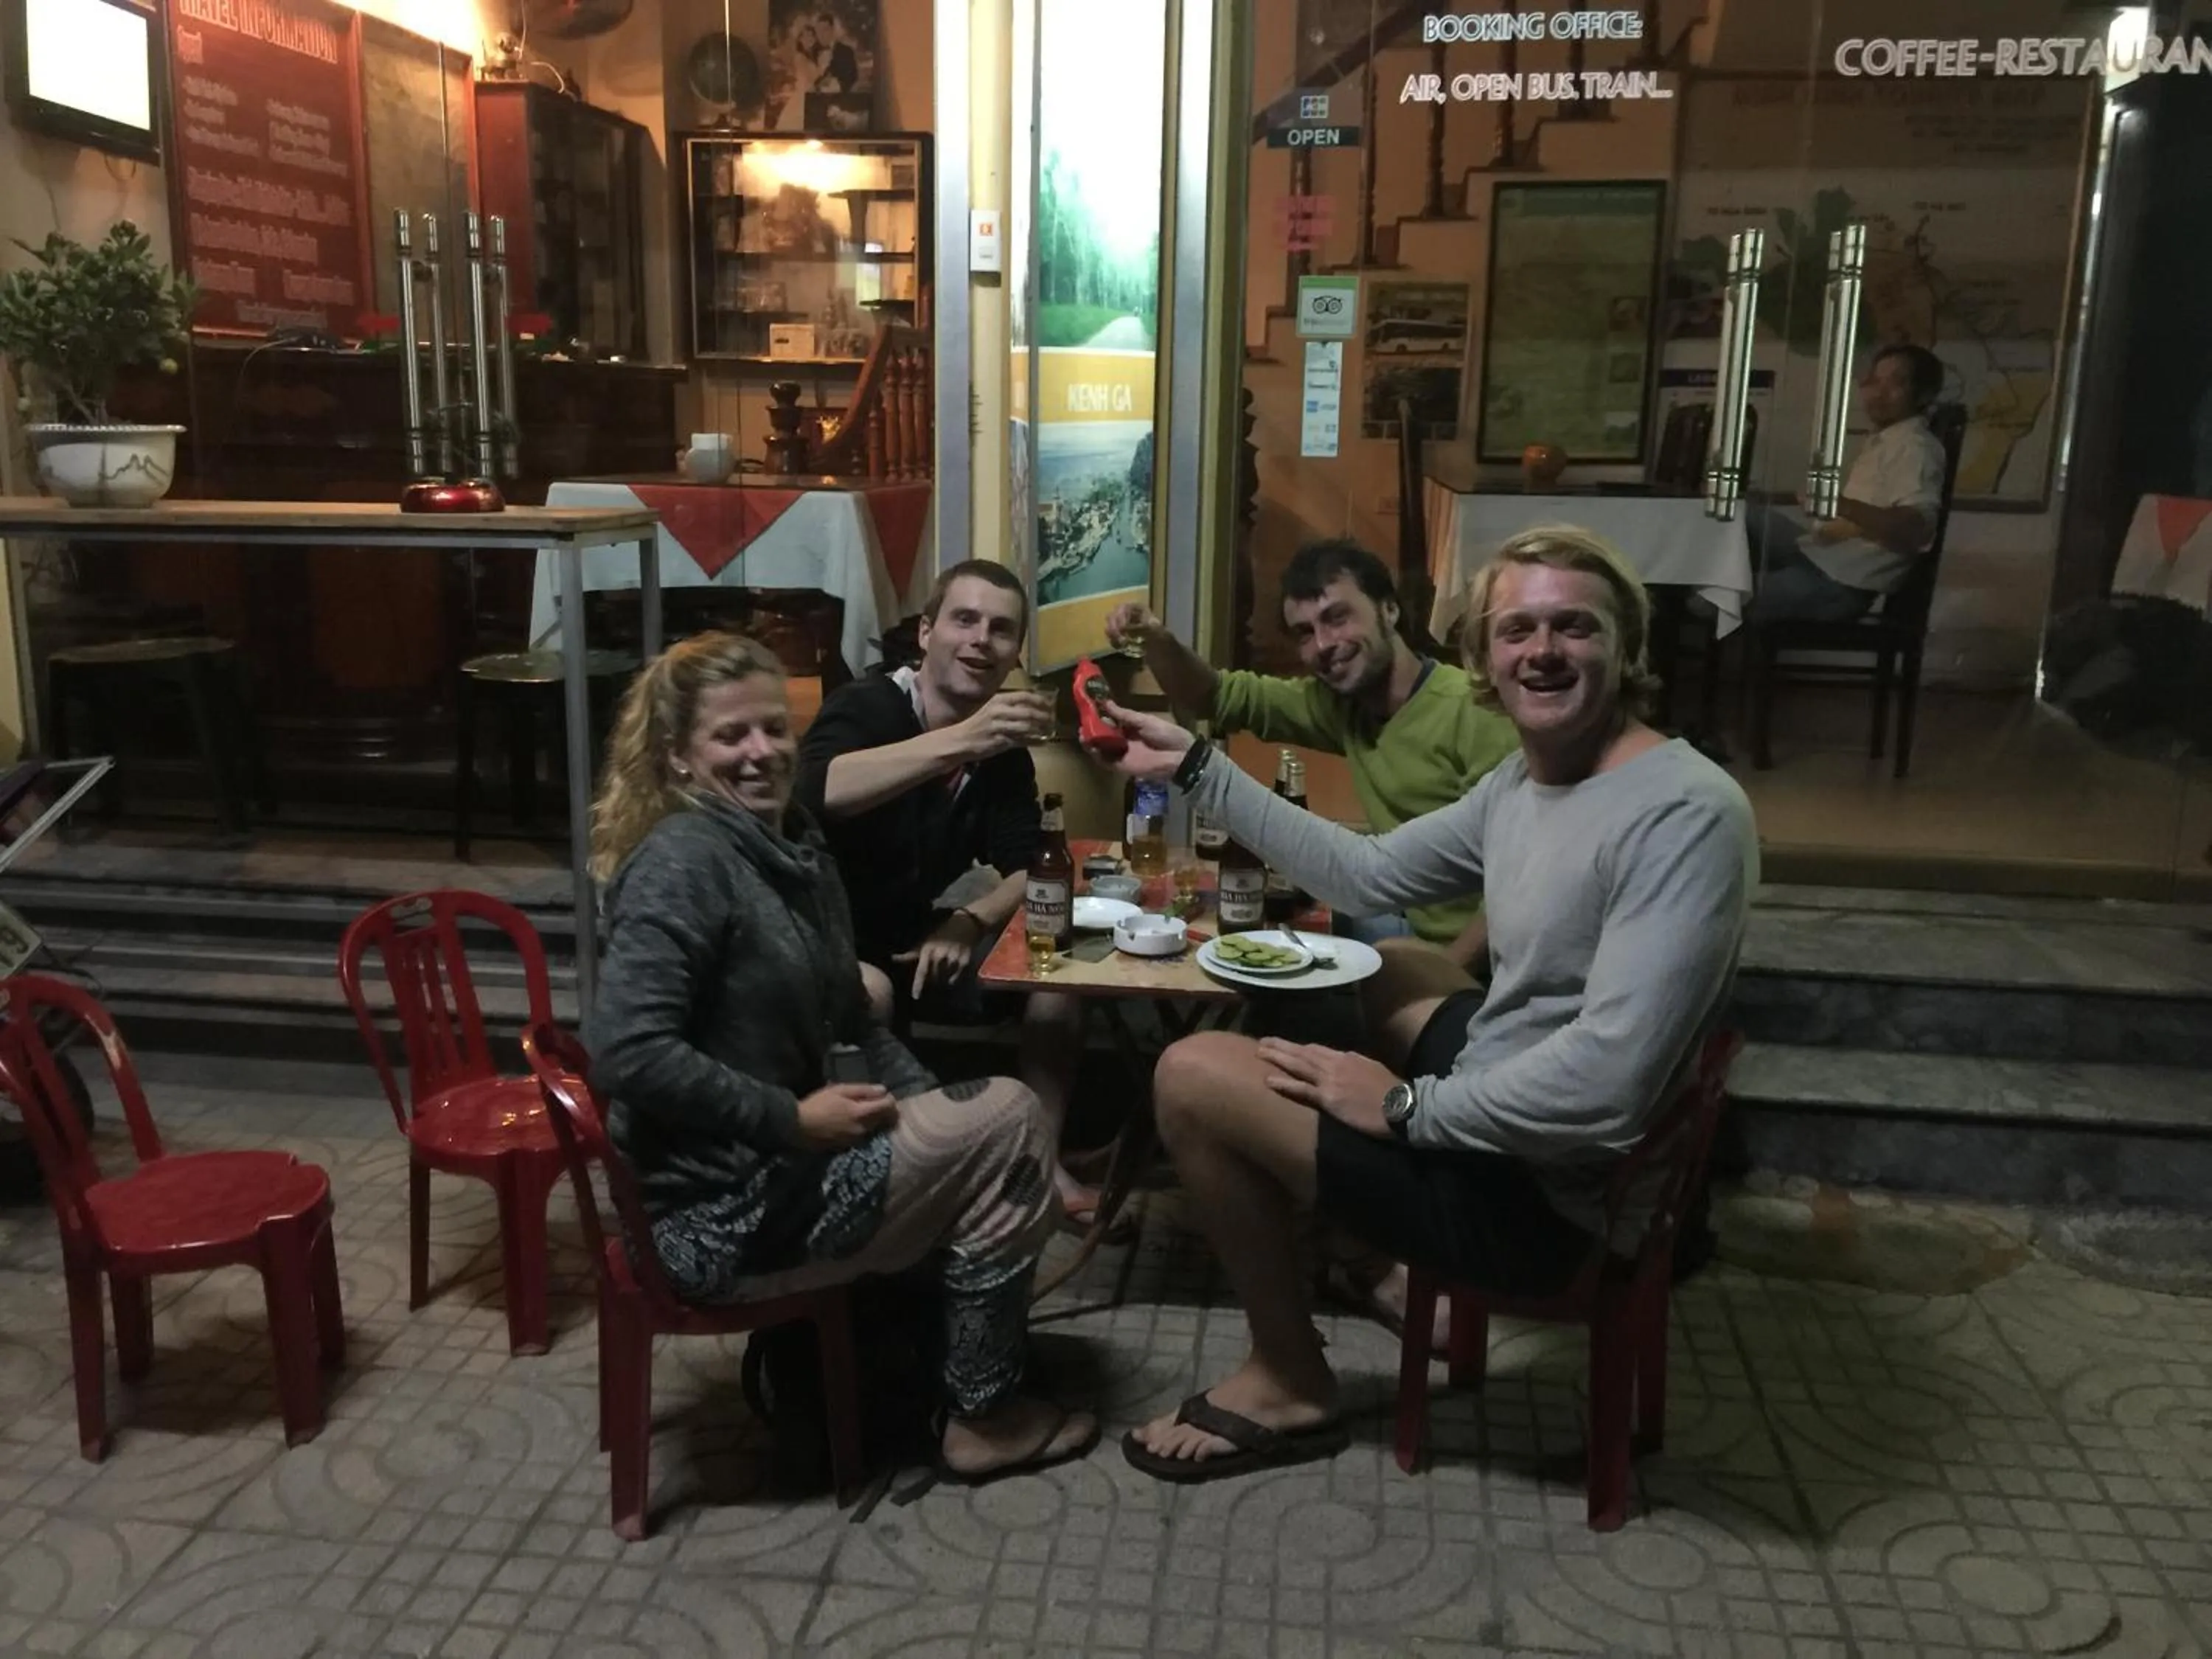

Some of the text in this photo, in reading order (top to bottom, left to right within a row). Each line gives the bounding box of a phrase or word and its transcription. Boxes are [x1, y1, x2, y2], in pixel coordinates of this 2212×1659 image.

[1424, 13, 1545, 43] BOOKING
[1399, 74, 1446, 105] AIR,
[1450, 73, 1523, 102] OPEN
[1287, 128, 1340, 146] OPEN
[1068, 383, 1133, 412] KENH GA
